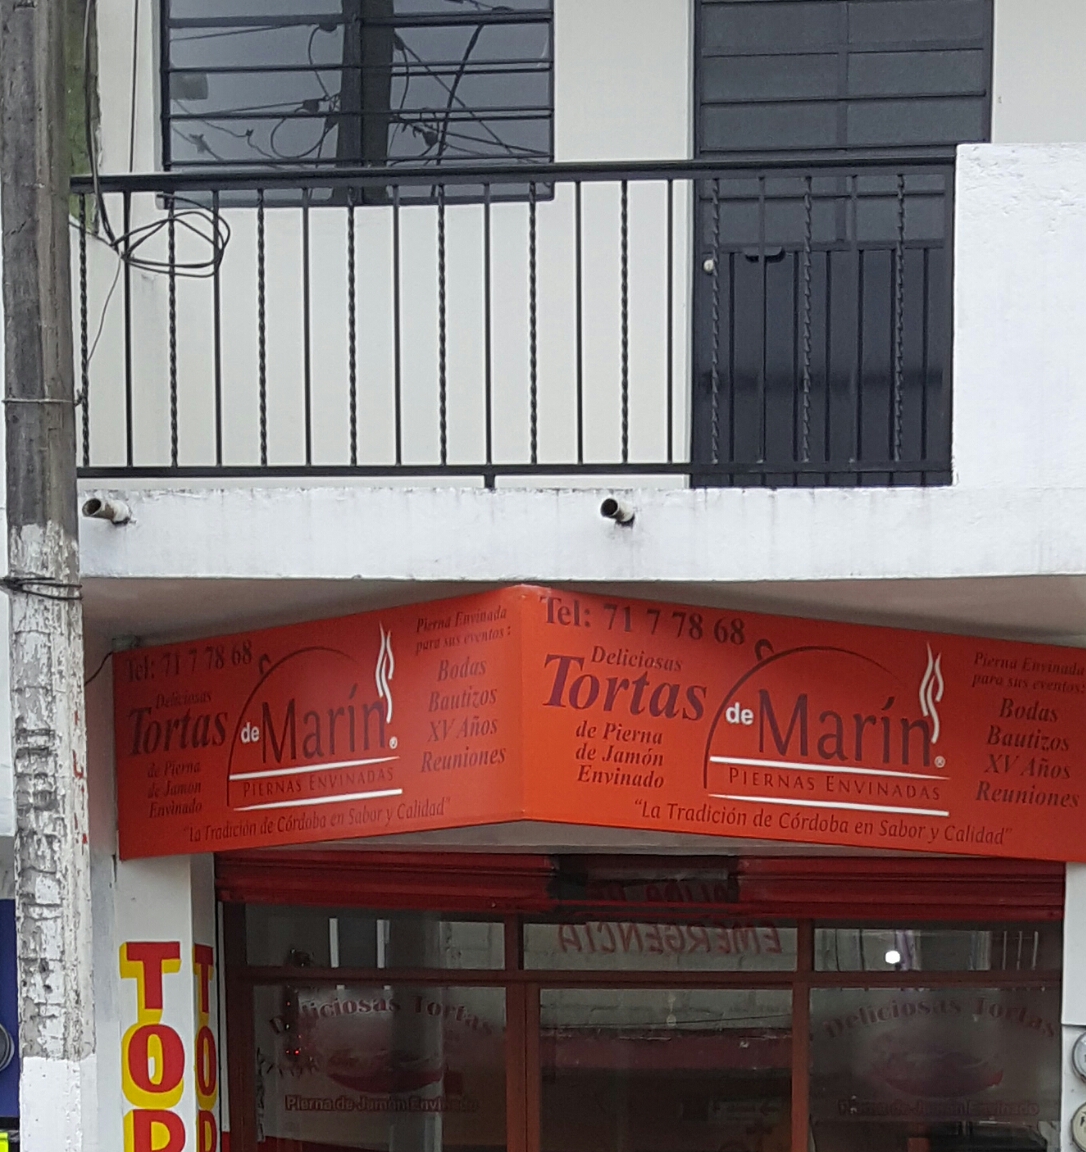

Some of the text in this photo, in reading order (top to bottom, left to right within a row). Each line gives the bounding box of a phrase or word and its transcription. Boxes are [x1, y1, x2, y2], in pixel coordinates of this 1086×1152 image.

[540, 596, 745, 646] Tel: 71 7 78 68
[125, 639, 253, 682] Tel: 71 7 78 68
[437, 658, 487, 683] Bodas
[590, 645, 683, 672] Deliciosas
[973, 651, 1085, 677] Pierna Envinada
[542, 653, 708, 721] Tortas
[971, 671, 1086, 695] para sus eventos:
[428, 686, 498, 713] Bautizos
[999, 697, 1058, 723] Bodas
[127, 705, 228, 756] Tortas
[240, 684, 387, 764] de Marín
[426, 714, 499, 744] XV Años
[575, 720, 663, 745] de Pierna
[725, 688, 932, 767] de Marín
[987, 725, 1070, 752] Bautizos
[420, 745, 507, 774] Reuniones
[575, 743, 664, 767] de Jamón
[984, 753, 1071, 780] XV Años
[147, 760, 201, 779] de Pierna
[243, 766, 395, 798] PIERNAS ENVINADAS
[576, 764, 664, 789] Envinado
[729, 766, 941, 801] PIERNAS ENVINADAS
[975, 781, 1080, 808] Reuniones
[149, 797, 203, 818] Envinado
[205, 820, 257, 841] Tradición
[260, 816, 274, 834] de
[277, 809, 327, 832] Córdoba
[330, 813, 345, 827] en
[348, 806, 383, 826] Sabor
[386, 809, 394, 826] y
[667, 803, 747, 826] Tradición
[753, 808, 772, 828] de
[778, 811, 849, 834] Córdoba
[855, 821, 874, 836] en
[879, 819, 926, 839] Sabor
[928, 828, 939, 844] y
